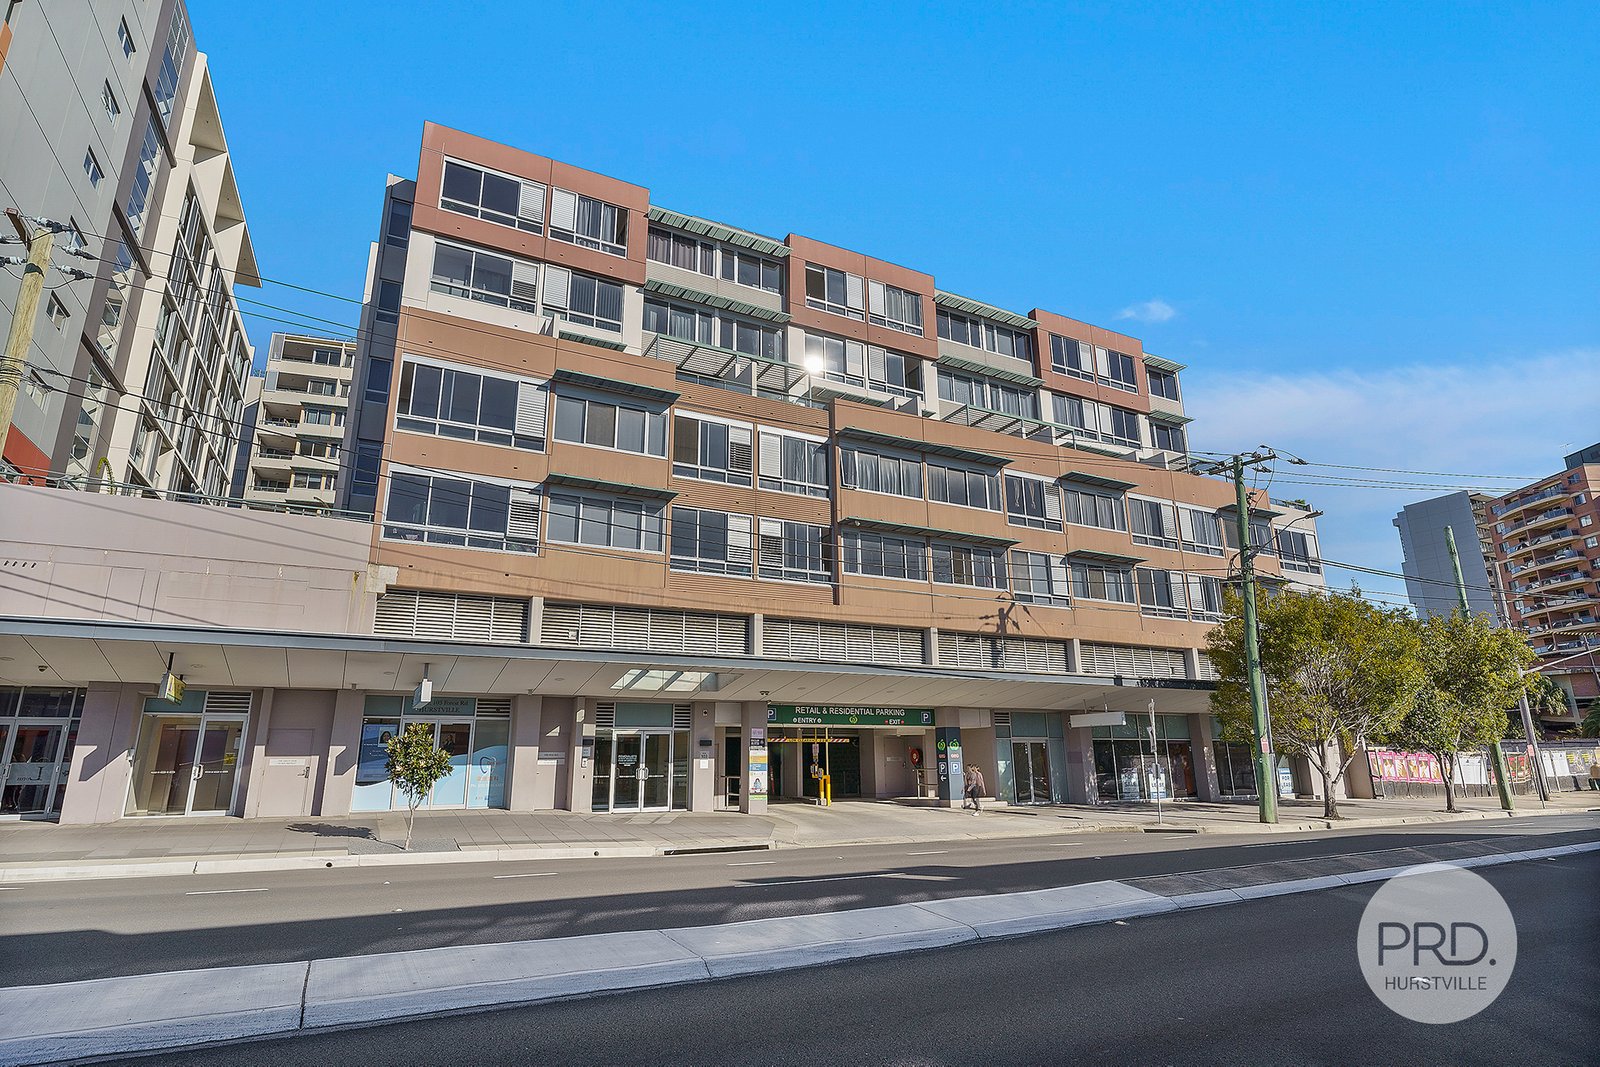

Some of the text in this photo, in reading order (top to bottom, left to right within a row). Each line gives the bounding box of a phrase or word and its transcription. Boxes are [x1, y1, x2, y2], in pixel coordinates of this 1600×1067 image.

[795, 706, 905, 717] RETAIL & RESIDENTIAL PARKING
[923, 713, 929, 722] P
[940, 763, 946, 773] P
[952, 763, 959, 773] P
